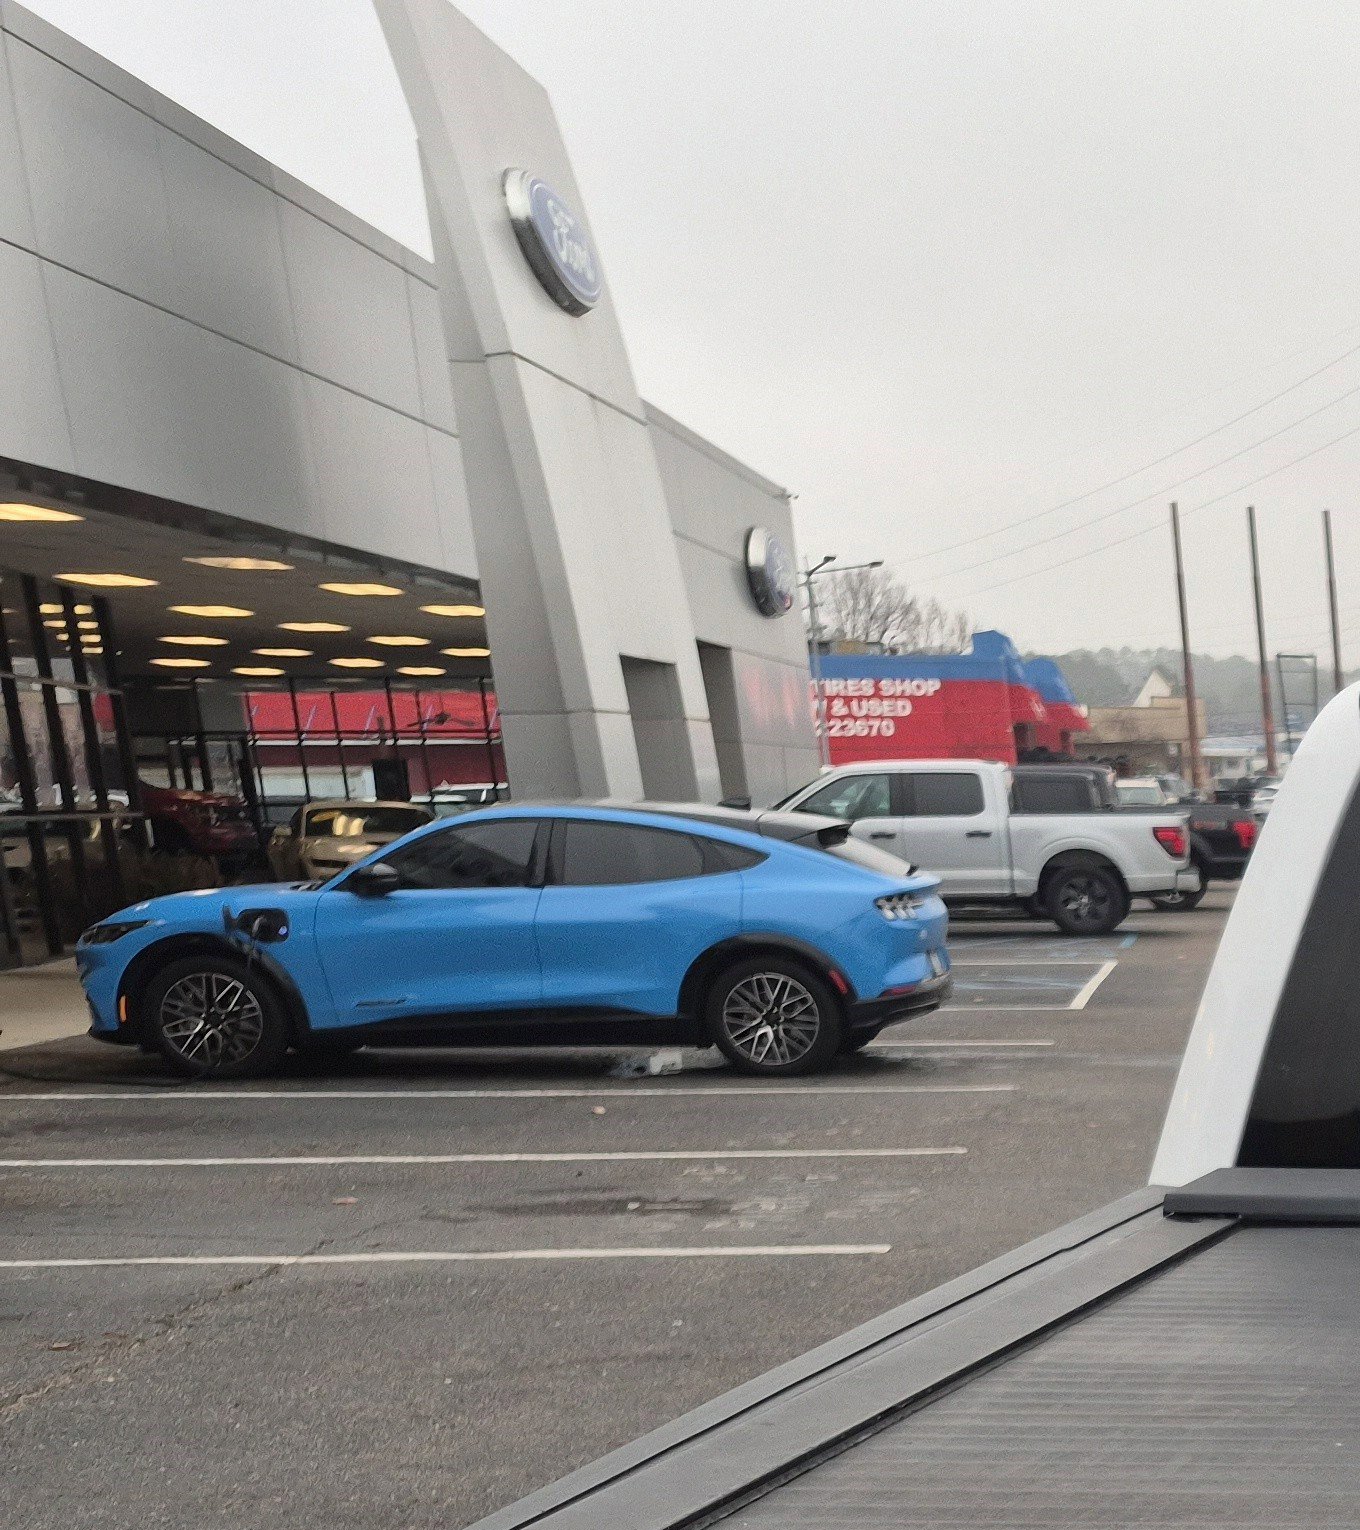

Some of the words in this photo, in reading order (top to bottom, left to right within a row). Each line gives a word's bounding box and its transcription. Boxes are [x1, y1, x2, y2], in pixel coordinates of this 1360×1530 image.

[878, 677, 941, 696] SHOP
[830, 697, 849, 717] &
[850, 697, 913, 717] USED
